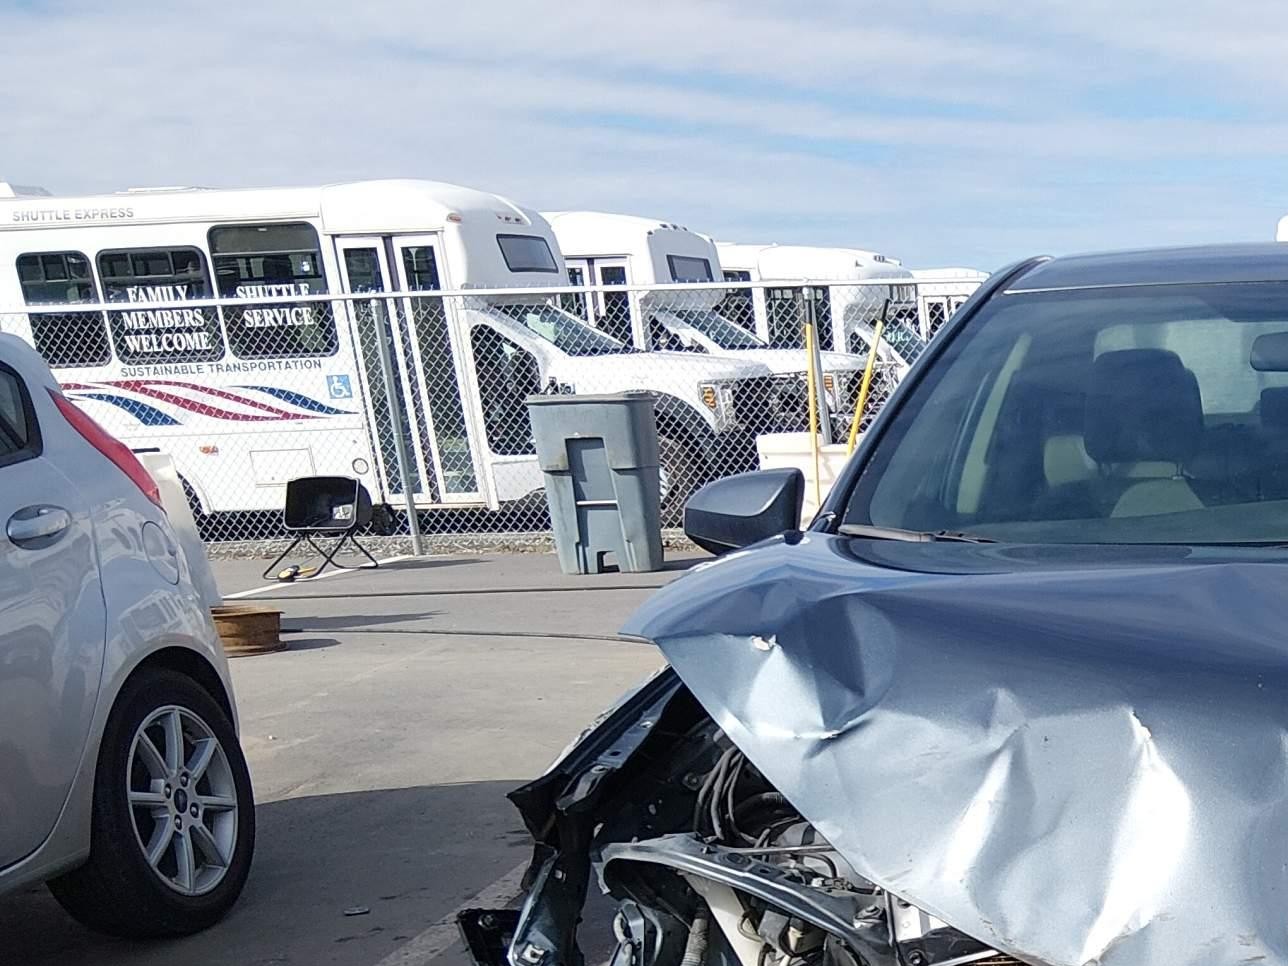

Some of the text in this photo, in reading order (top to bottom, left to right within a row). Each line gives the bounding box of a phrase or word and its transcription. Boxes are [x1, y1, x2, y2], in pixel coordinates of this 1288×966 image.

[12, 206, 134, 222] SHUTTLE EXPRESS
[126, 285, 188, 303] FAMILY
[236, 283, 310, 299] SHUTTLE
[121, 308, 205, 330] MEMBERS
[243, 307, 315, 328] SERVICE
[124, 331, 212, 352] WELCOME
[120, 359, 322, 378] SUSTAINABLE TRANSPORTATION
